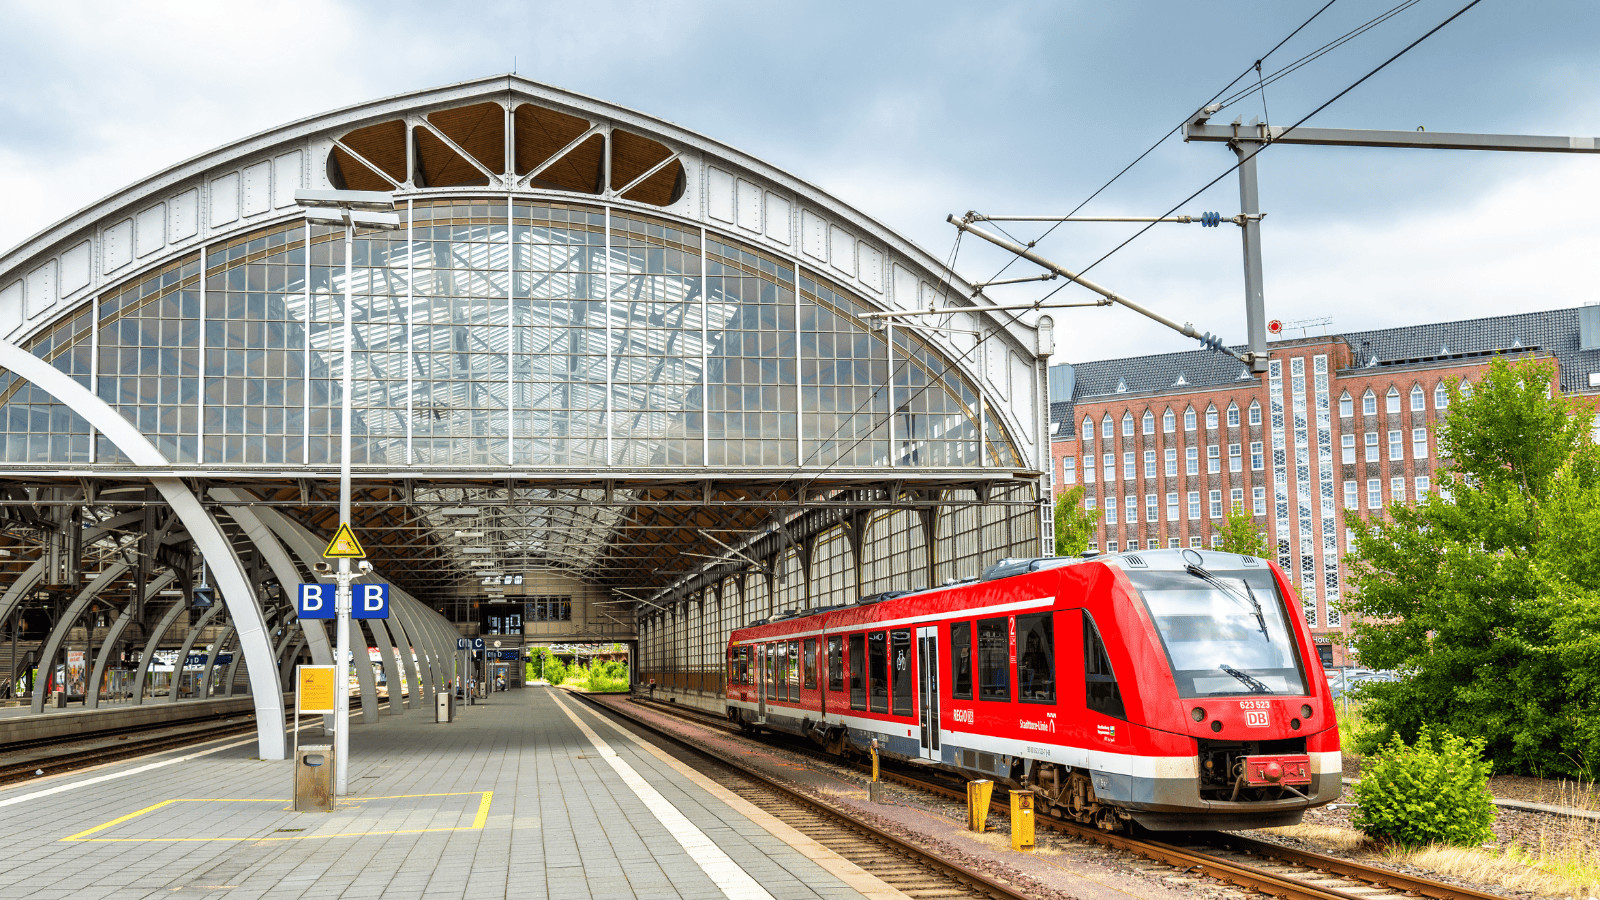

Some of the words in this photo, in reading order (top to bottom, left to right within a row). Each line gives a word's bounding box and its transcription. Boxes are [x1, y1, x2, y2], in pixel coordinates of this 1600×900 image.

[303, 585, 323, 611] B
[364, 585, 384, 611] B
[1010, 617, 1014, 636] 2
[475, 638, 482, 648] C
[1240, 701, 1254, 709] 623
[1256, 700, 1270, 708] 523
[953, 708, 968, 722] REGIO
[1246, 711, 1268, 726] DB
